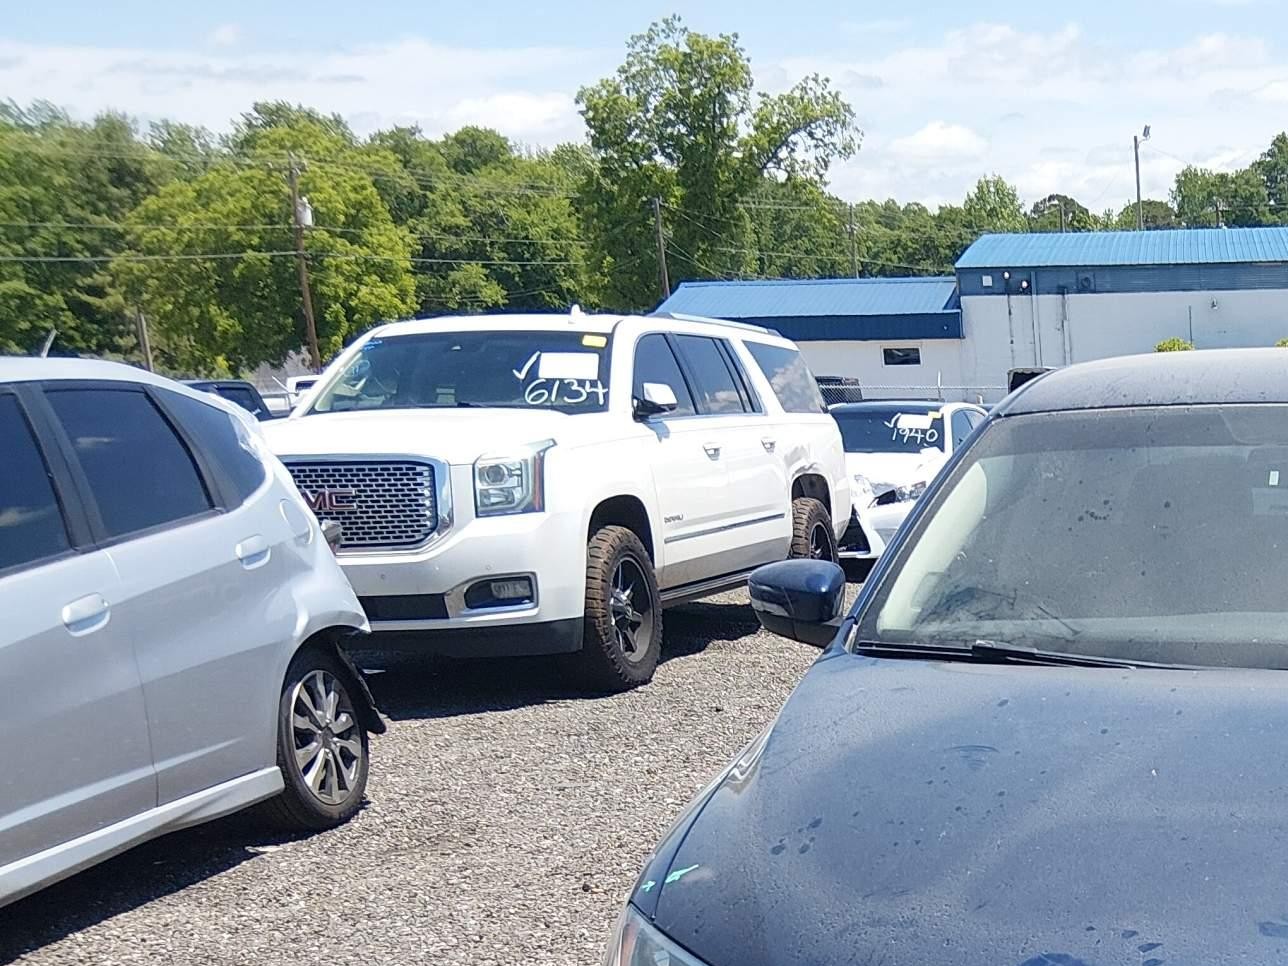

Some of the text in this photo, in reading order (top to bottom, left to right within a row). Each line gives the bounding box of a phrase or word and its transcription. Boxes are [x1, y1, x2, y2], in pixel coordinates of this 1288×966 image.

[524, 378, 609, 405] 6134
[892, 427, 939, 444] 1940
[300, 488, 358, 511] MC
